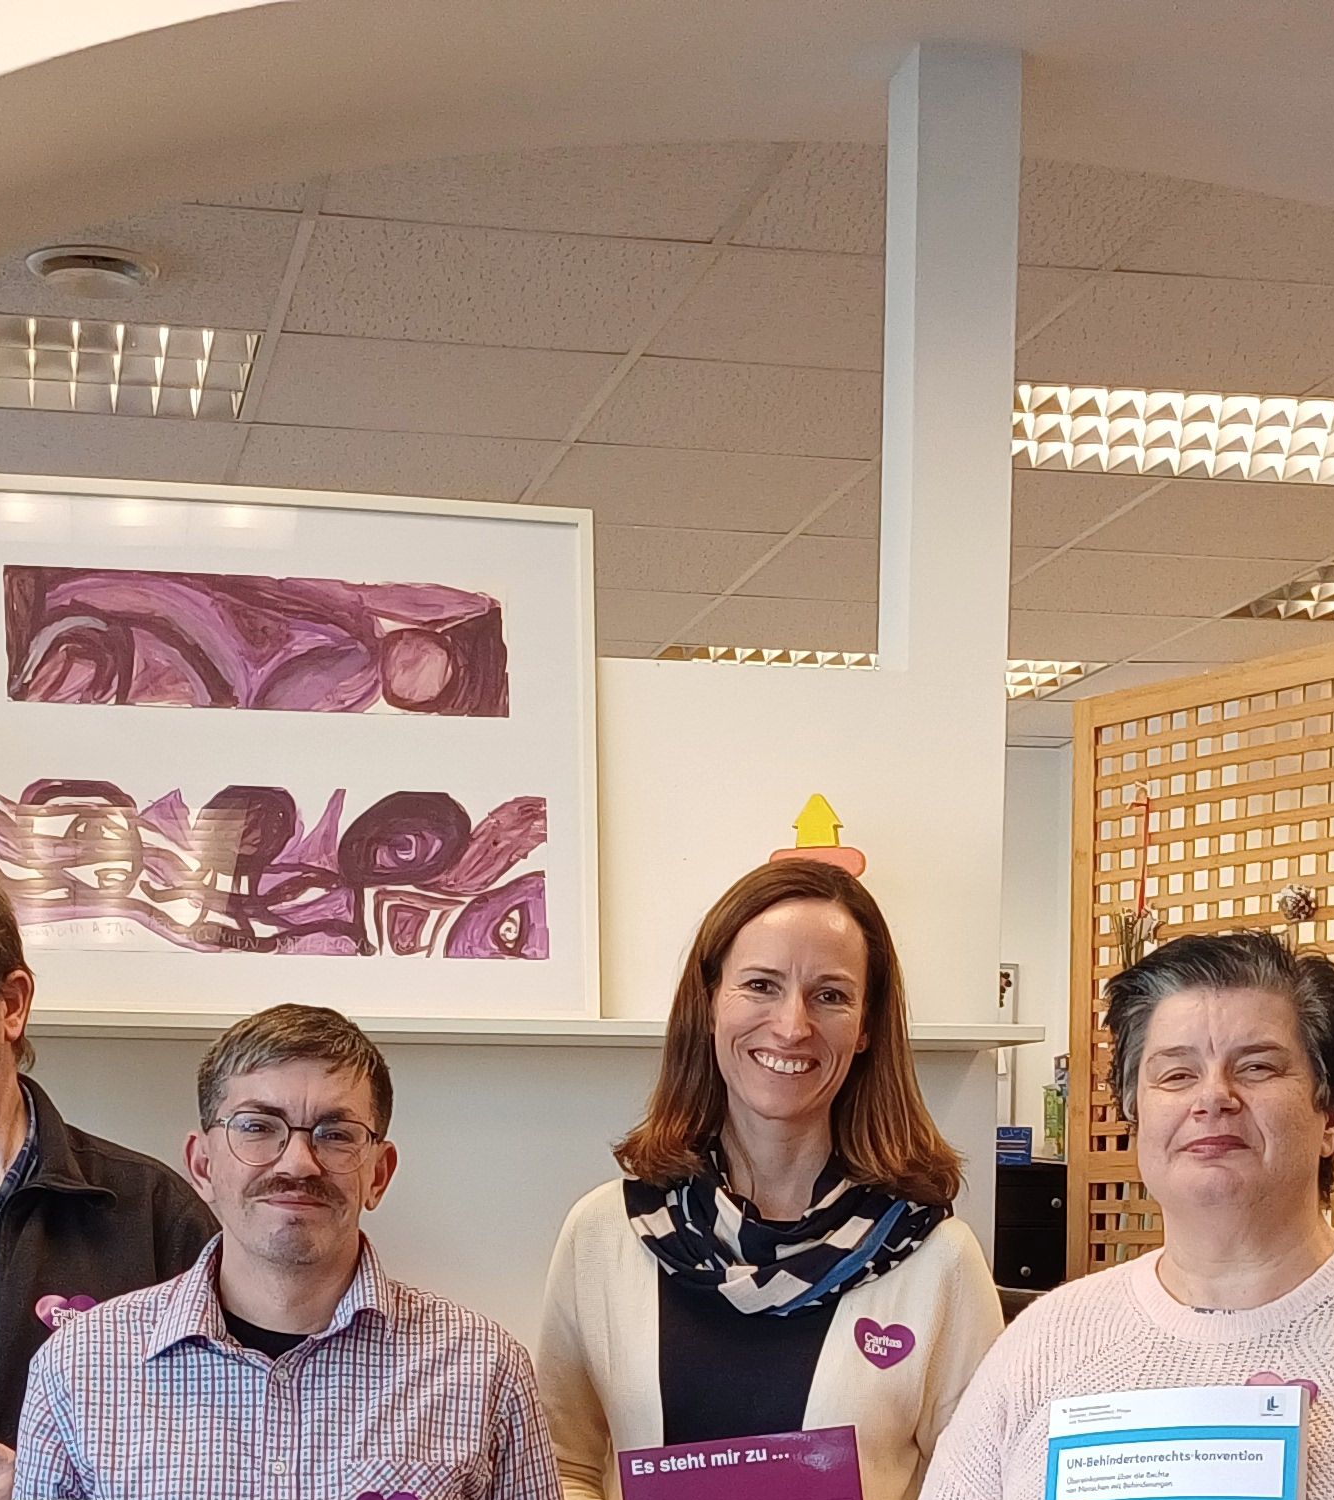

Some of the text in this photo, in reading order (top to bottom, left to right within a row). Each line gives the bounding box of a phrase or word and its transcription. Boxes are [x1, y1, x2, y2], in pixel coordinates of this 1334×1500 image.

[864, 1332, 903, 1349] Caritas
[631, 1459, 655, 1476] Es
[659, 1453, 707, 1473] steht
[710, 1448, 741, 1467] mir
[745, 1448, 767, 1463] zu
